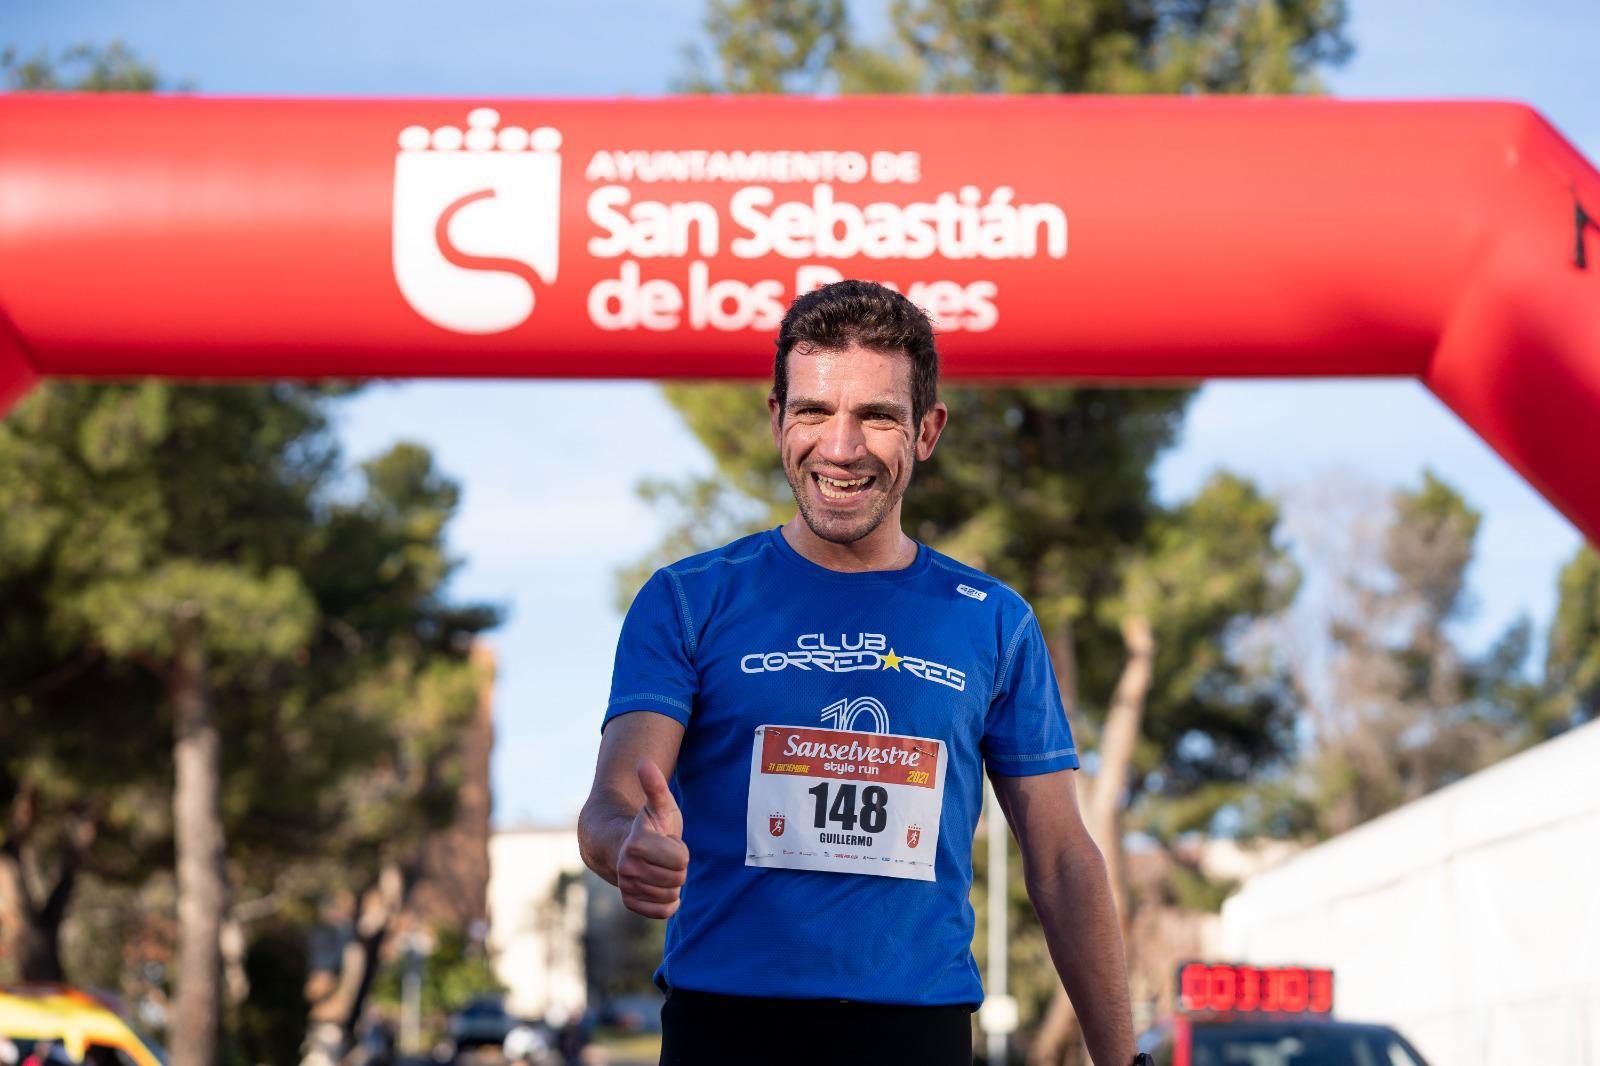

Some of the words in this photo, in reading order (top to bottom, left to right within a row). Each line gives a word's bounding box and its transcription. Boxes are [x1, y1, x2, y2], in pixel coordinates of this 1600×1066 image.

[587, 150, 868, 183] AYUNTAMIENTO
[869, 150, 921, 183] DE
[587, 186, 719, 258] San
[731, 184, 1068, 259] Sebastián
[587, 260, 683, 331] de
[690, 261, 785, 331] los
[797, 632, 887, 651] CLUB
[783, 734, 921, 767] Sanselvestre
[776, 763, 811, 773] DICIEMBRE
[823, 761, 856, 775] style
[858, 765, 879, 775] run
[905, 770, 930, 785] 2021
[808, 782, 889, 834] 148
[819, 832, 873, 847] GUILLERMO
